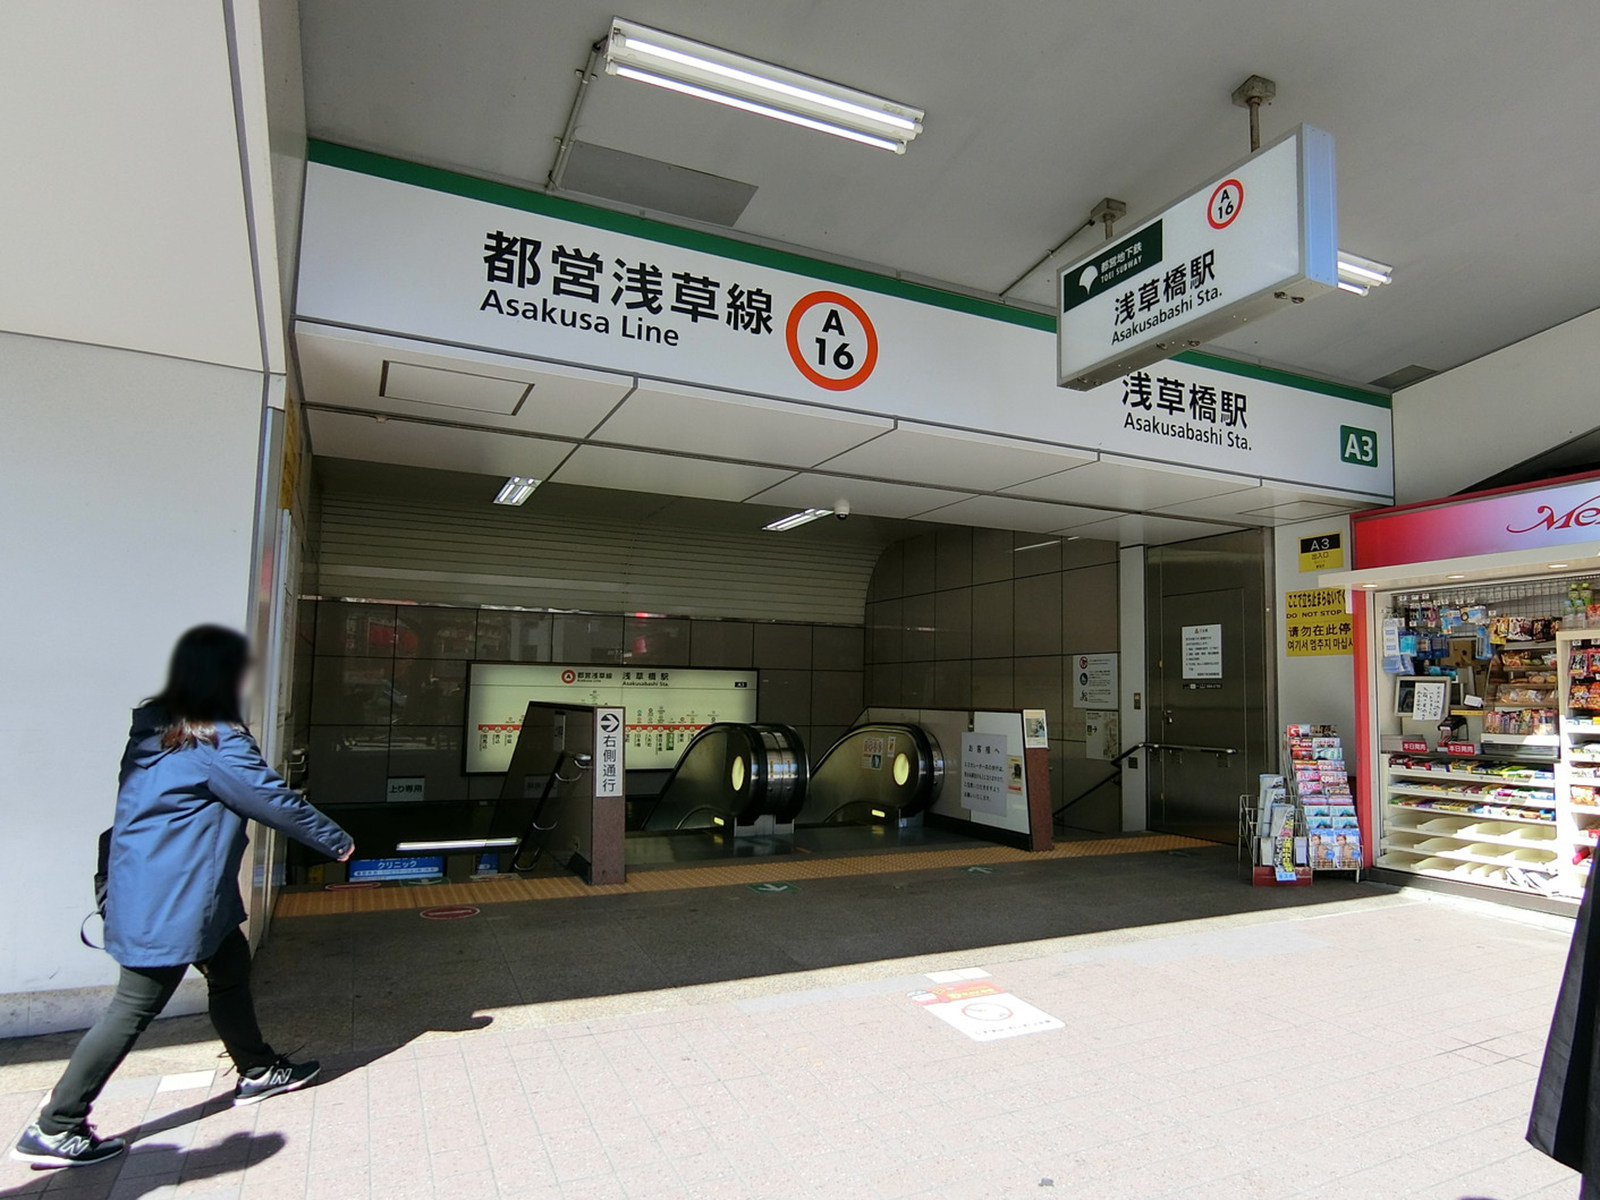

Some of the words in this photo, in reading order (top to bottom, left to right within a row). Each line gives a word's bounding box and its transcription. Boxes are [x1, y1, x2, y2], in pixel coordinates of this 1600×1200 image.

[1218, 201, 1234, 219] 16
[1220, 189, 1230, 203] A
[1101, 242, 1142, 273] 都営地下鉄
[1101, 271, 1114, 283] TOEI
[1116, 255, 1142, 275] SUBWAY
[483, 231, 773, 336] 都営浅草線
[1113, 249, 1216, 326] 浅草橋駅
[480, 290, 610, 334] Asakusa
[622, 318, 679, 347] Line
[822, 309, 845, 336] A
[1111, 299, 1193, 345] Asakusabashi
[1197, 285, 1223, 305] Sta.
[815, 337, 855, 370] 16
[1122, 371, 1248, 429] 浅草橋駅
[1124, 411, 1222, 446] Asakusabashi
[1227, 431, 1252, 451] Sta.
[1344, 433, 1374, 462] A3
[1506, 494, 1600, 533] Me
[1310, 538, 1330, 551] A3
[1312, 551, 1329, 560] 出入口
[622, 671, 669, 681] 浅草橋駅
[602, 734, 617, 792] 右側通行
[389, 784, 423, 794] 上り専用
[378, 860, 417, 869] クリニック
